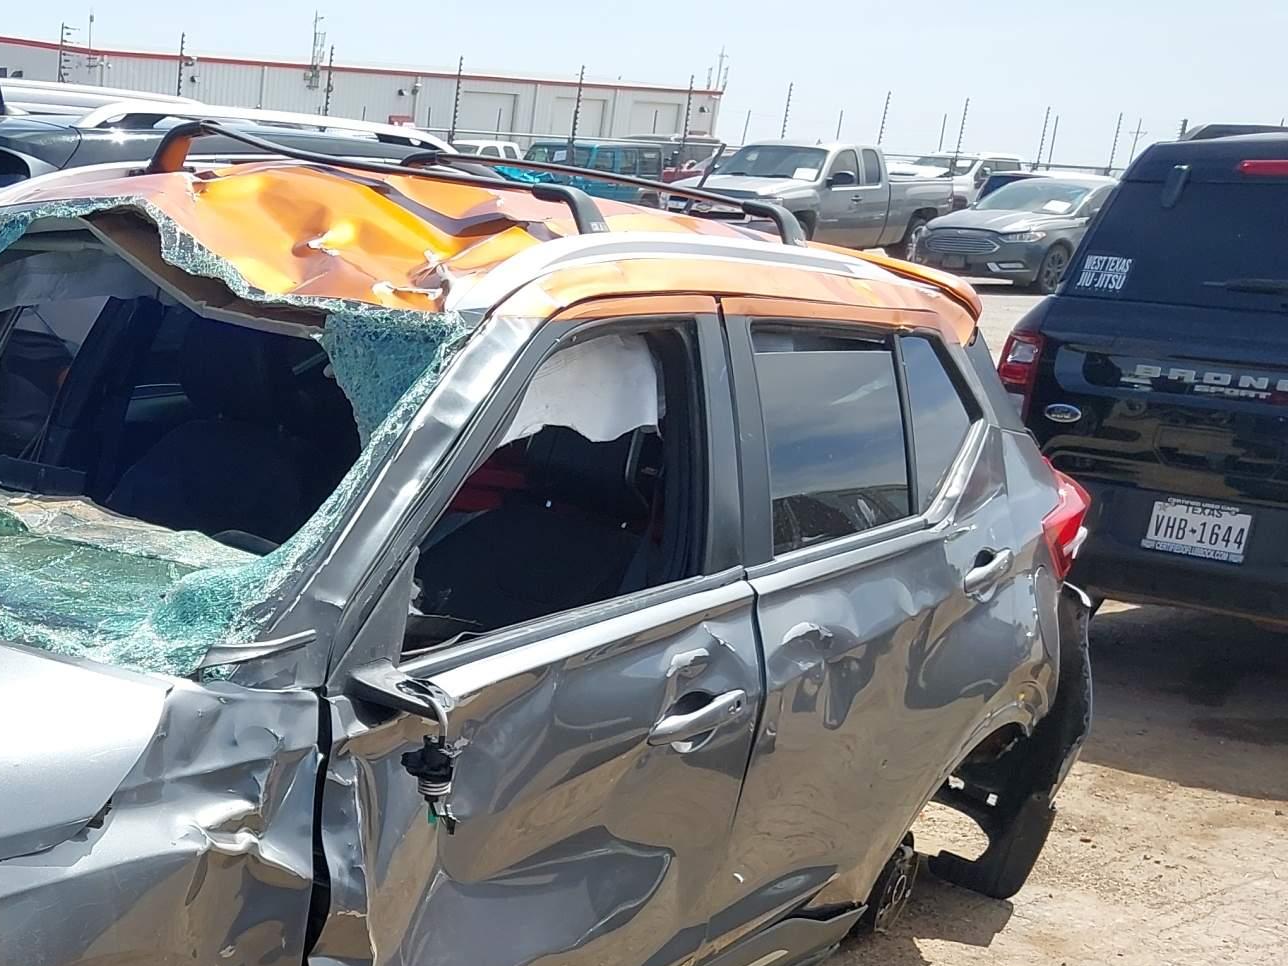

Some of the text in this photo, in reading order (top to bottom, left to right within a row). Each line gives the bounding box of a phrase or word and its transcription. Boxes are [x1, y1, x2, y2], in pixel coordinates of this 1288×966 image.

[1084, 255, 1132, 273] WEST TEXAS
[1193, 384, 1272, 399] SPORT
[1185, 505, 1223, 518] TEXAS
